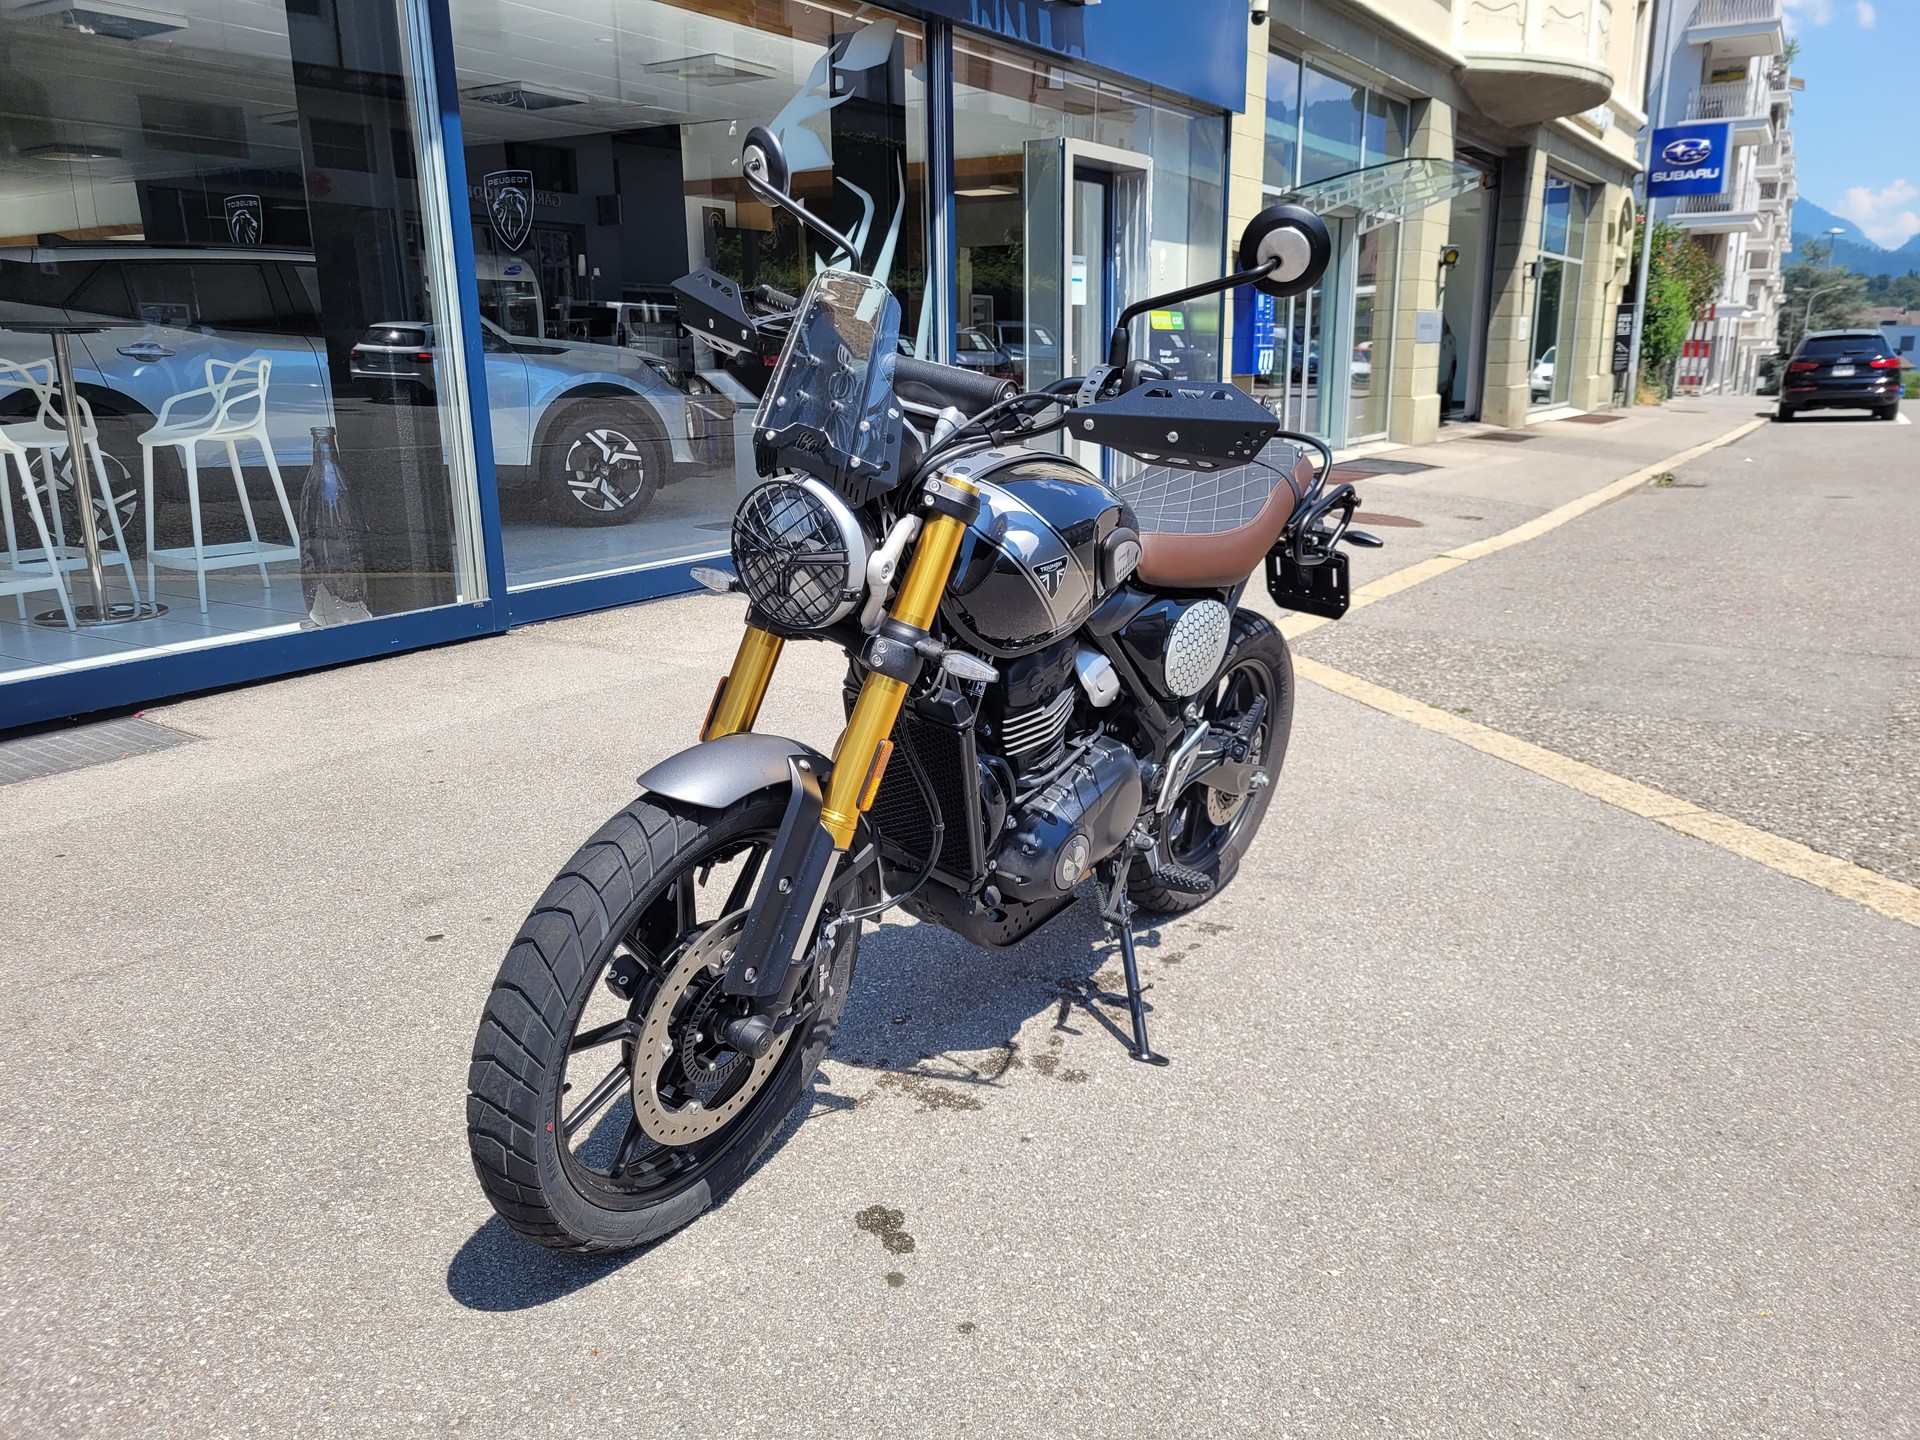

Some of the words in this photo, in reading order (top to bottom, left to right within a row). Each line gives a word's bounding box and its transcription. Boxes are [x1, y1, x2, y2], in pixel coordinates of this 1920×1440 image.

[1651, 167, 1720, 182] SUBARU
[487, 176, 529, 186] PEUGEOT
[1040, 561, 1063, 573] TRIUMPH
